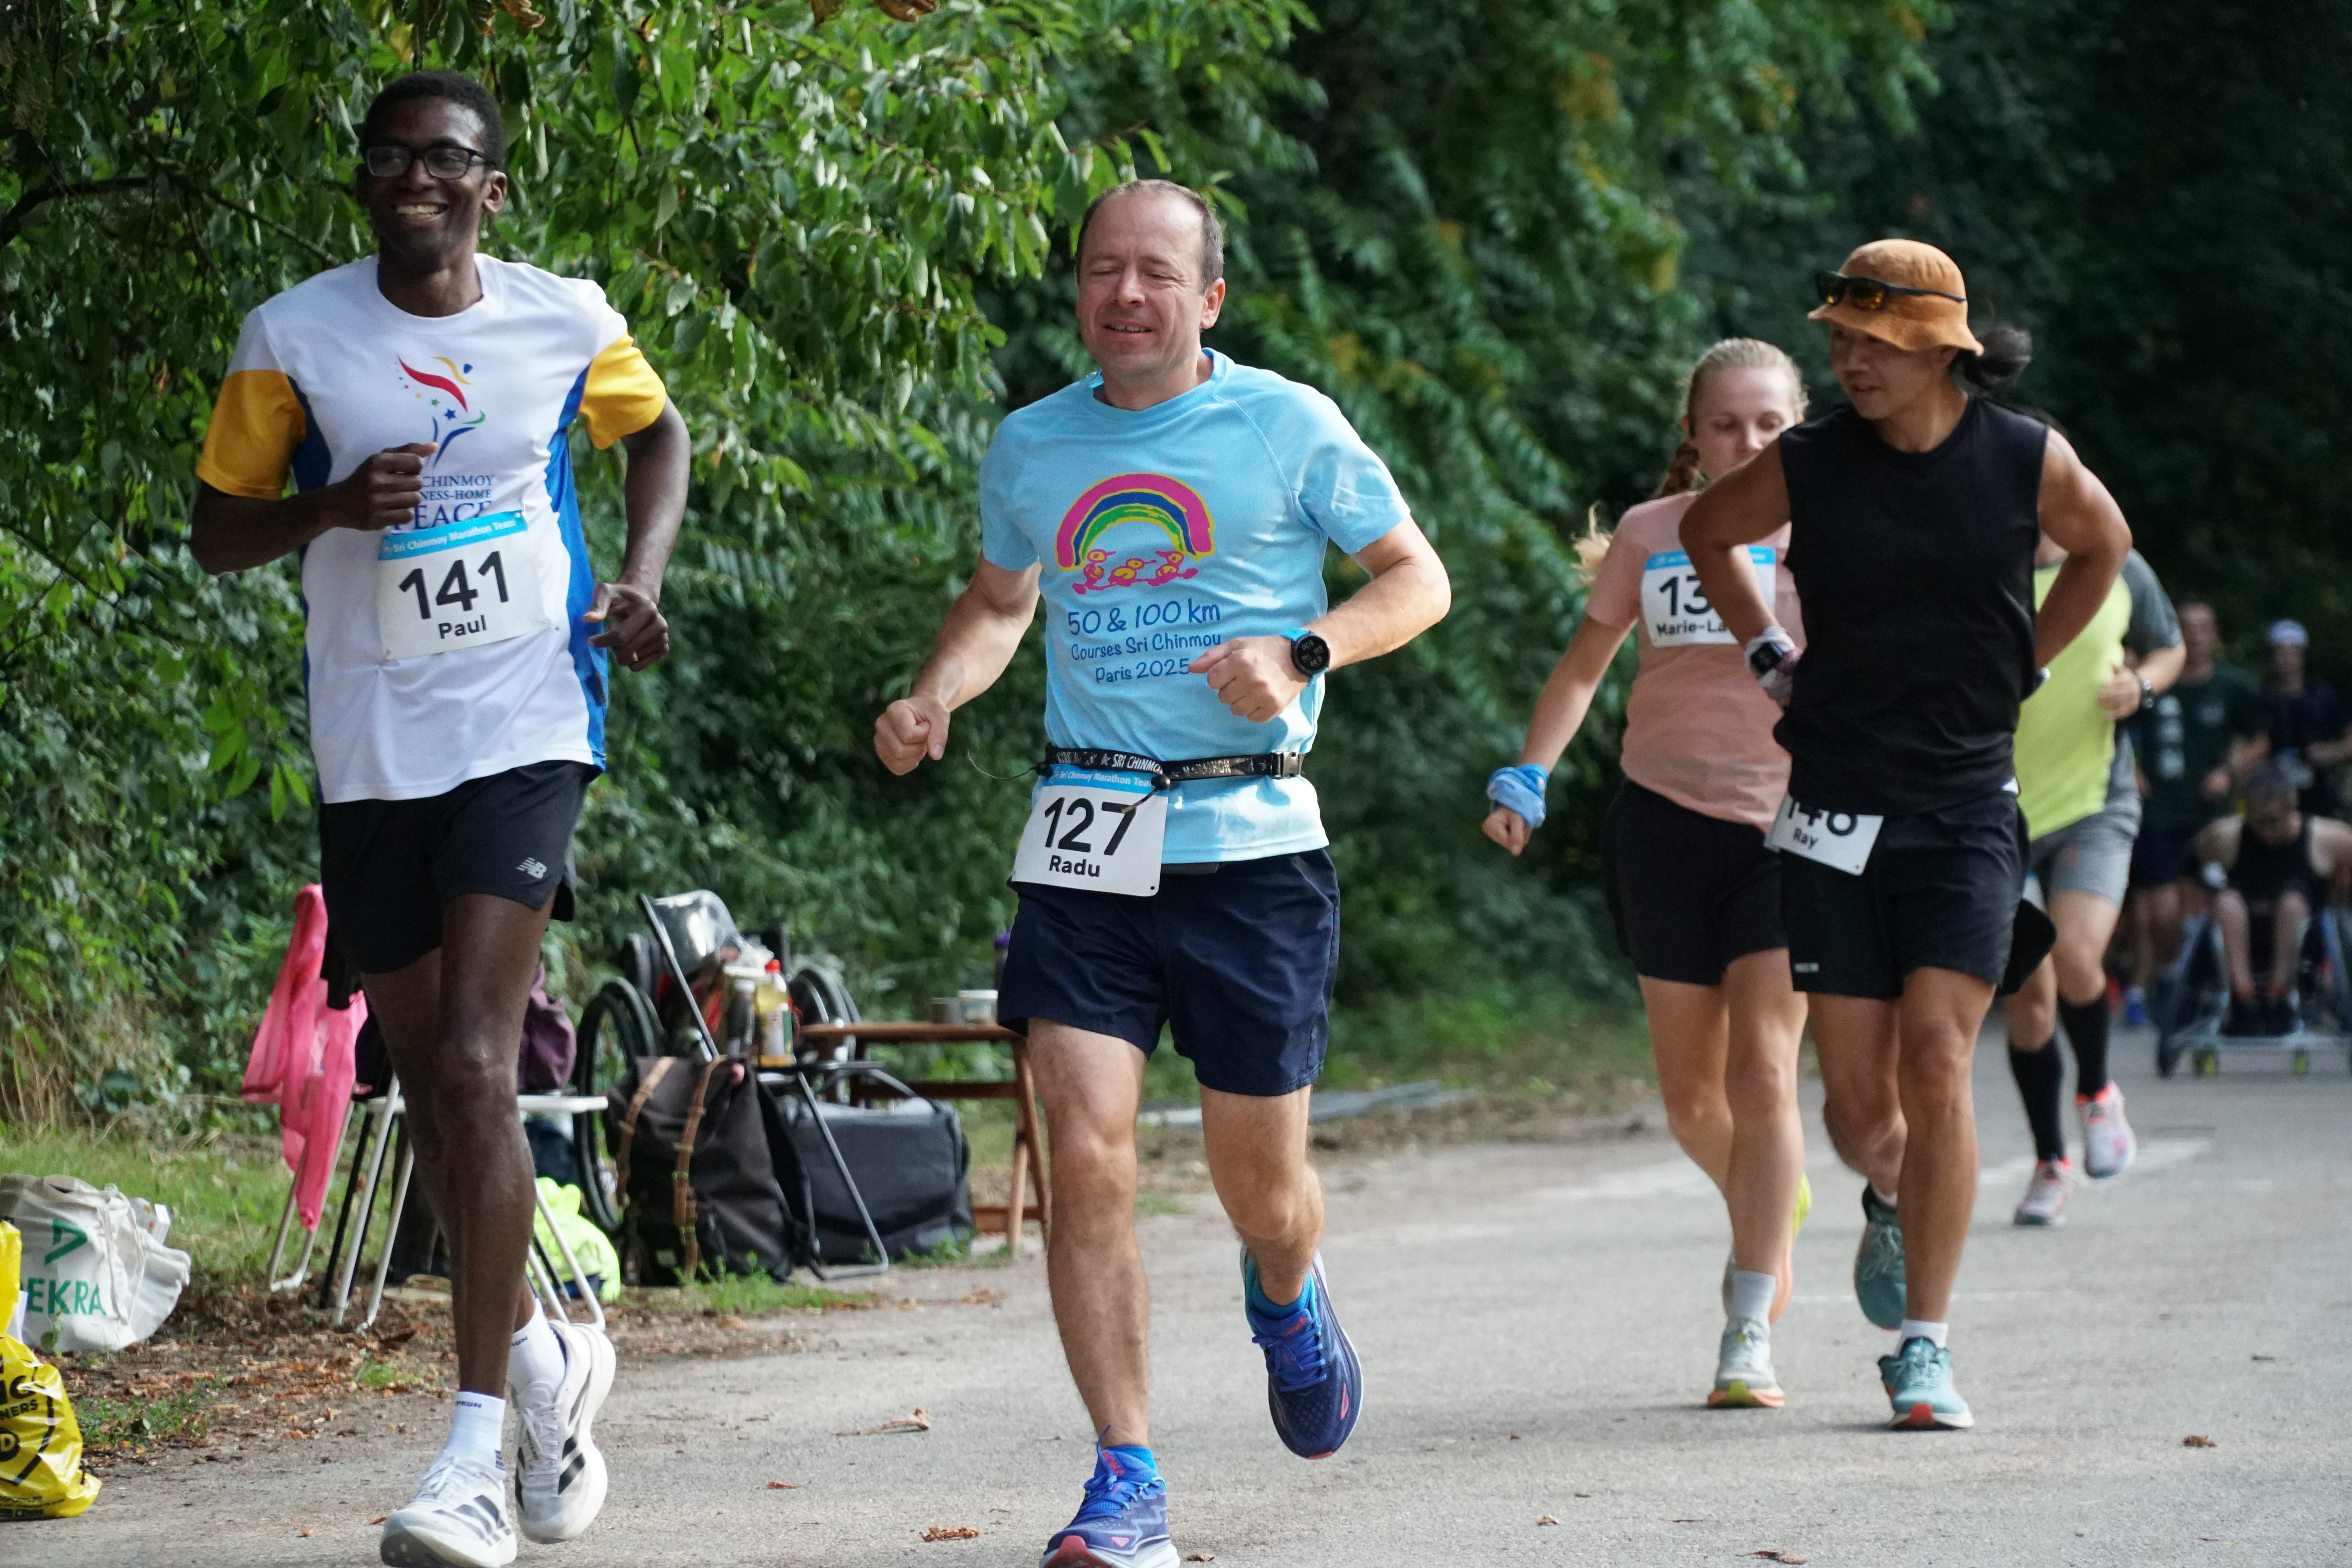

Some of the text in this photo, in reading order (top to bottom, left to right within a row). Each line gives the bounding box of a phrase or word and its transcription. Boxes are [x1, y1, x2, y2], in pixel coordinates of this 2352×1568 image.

[422, 475, 495, 487] CHINMOY
[419, 489, 492, 501] NESS-HOME
[394, 520, 516, 552] Sri Chinmoy Marathon Team
[399, 550, 509, 620] 141
[1659, 575, 1713, 616] 13
[438, 615, 487, 639] Paul
[1068, 598, 1220, 635] 50 & 100 km
[1071, 644, 1122, 661] Courses
[1126, 637, 1148, 654] Sri
[1096, 657, 1190, 684] Paris 2025
[1112, 754, 1127, 768] SRI
[1127, 756, 1163, 775] CHINMO
[1059, 771, 1152, 788] Sri Chinmoy Marathon Tea
[1045, 797, 1137, 856] 127
[1793, 827, 1819, 850] Ray
[1049, 855, 1101, 877] Radu
[21, 1277, 107, 1316] EKRA
